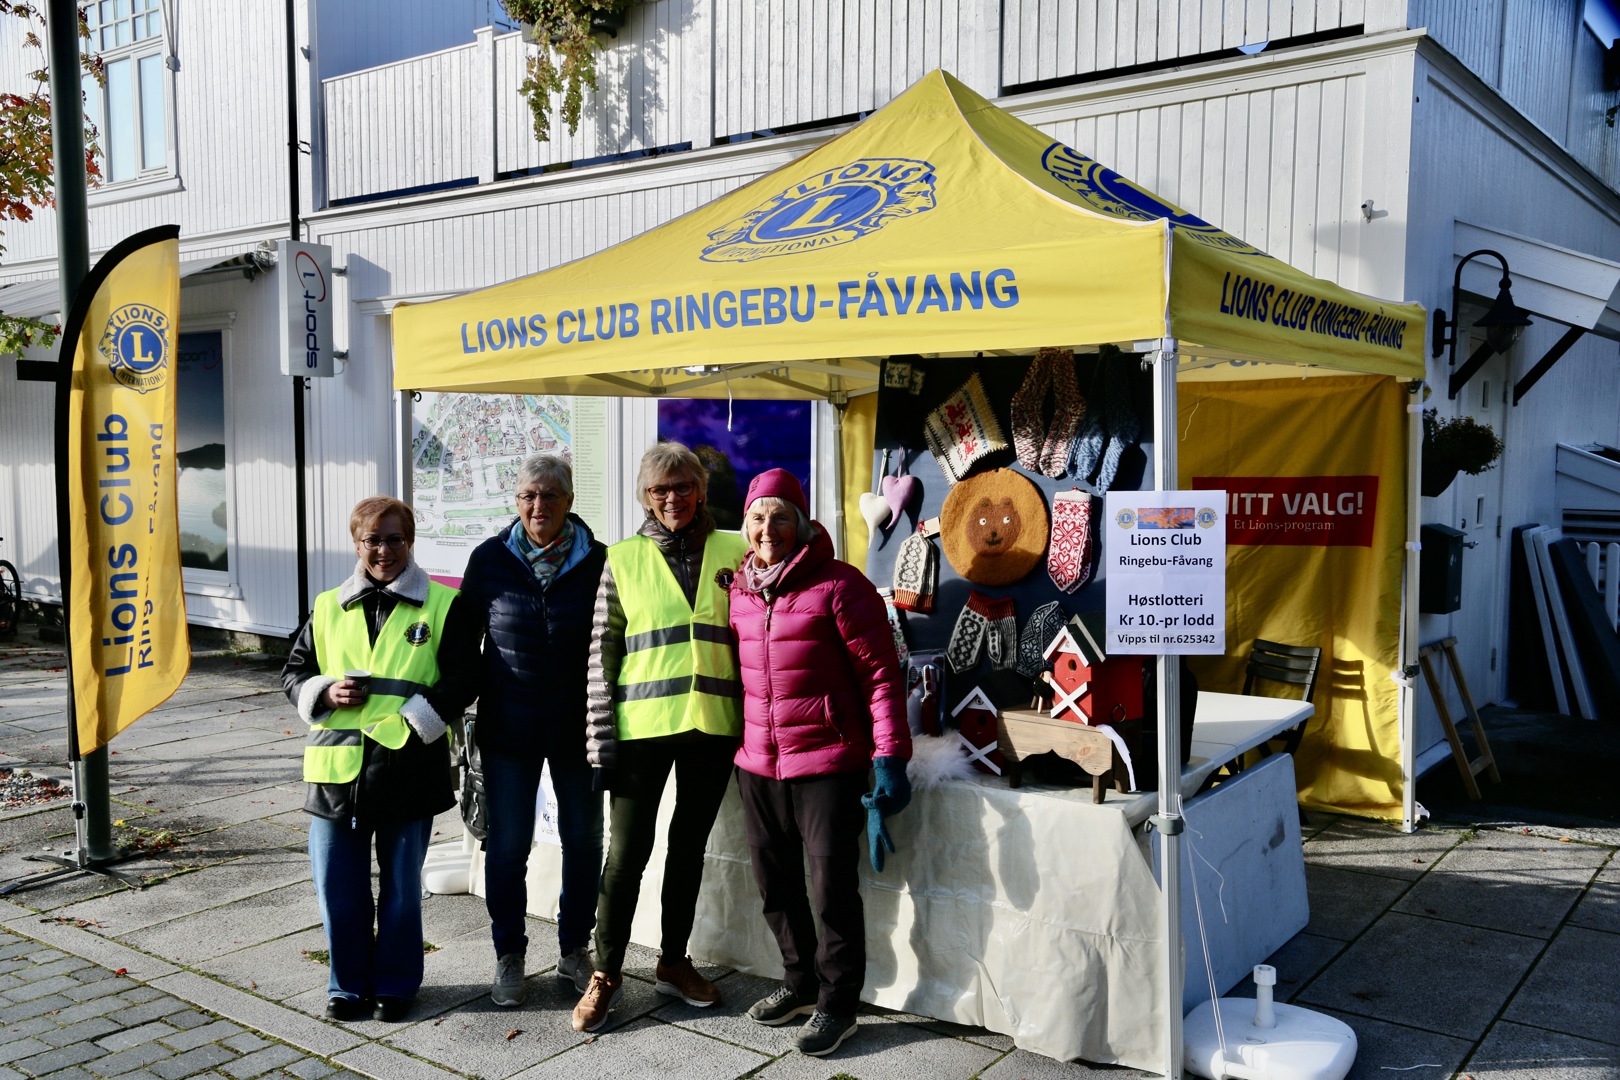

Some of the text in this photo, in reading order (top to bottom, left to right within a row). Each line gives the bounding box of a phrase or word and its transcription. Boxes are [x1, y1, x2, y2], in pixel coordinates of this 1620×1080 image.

[796, 162, 922, 196] LIONS
[779, 194, 847, 232] L
[716, 235, 843, 258] INTERNATIONAL
[115, 307, 165, 328] LIONS
[460, 268, 1020, 354] LIONS CLUB RINGEBU-FÅVANG
[1220, 271, 1407, 350] LIONS CLUB RINGEBU-FÅVANG
[303, 289, 320, 368] sport
[130, 331, 154, 363] L
[1282, 491, 1364, 515] VALG!
[1234, 519, 1335, 532] Et Lions-program
[97, 413, 138, 677] Lions Club
[1130, 533, 1202, 546] Lions Club
[1119, 555, 1213, 568] Ringebu-Fåvang
[1128, 594, 1203, 607] Høstlotteri
[1119, 614, 1134, 626] Kr
[1183, 613, 1214, 626] lodd
[1117, 634, 1215, 645] Vipps til nr.625342
